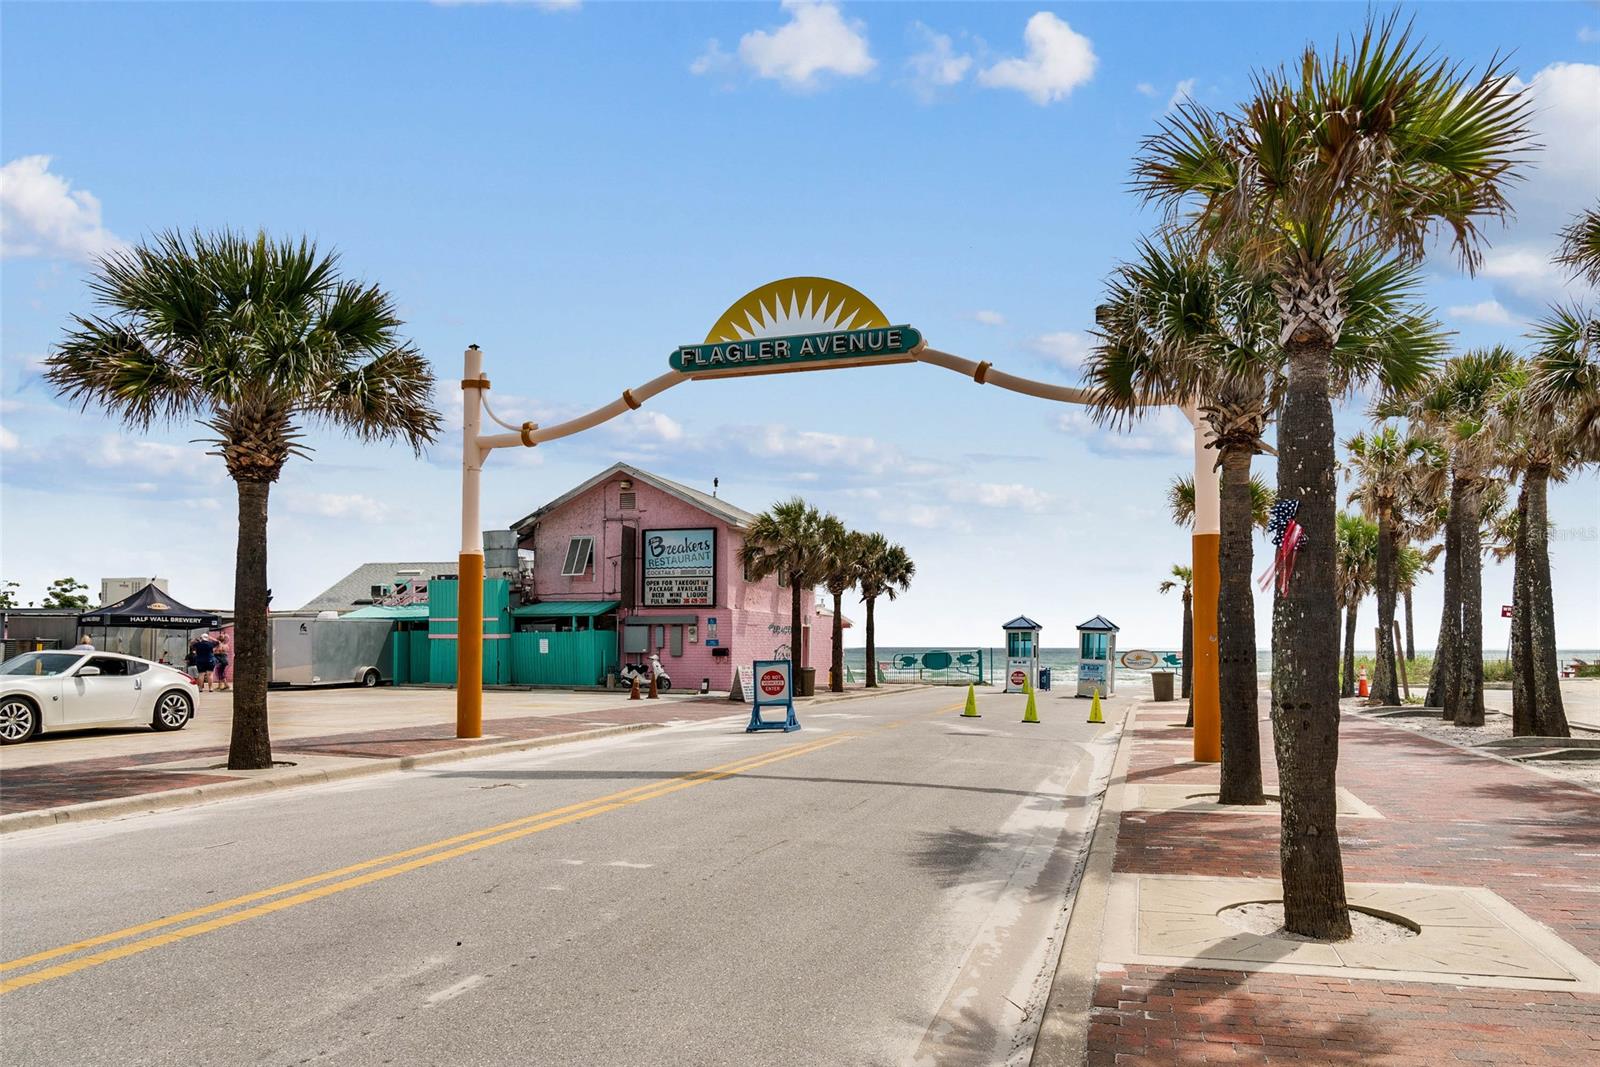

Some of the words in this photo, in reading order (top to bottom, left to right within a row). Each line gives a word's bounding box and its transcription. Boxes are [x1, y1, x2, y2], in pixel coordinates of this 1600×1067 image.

[680, 340, 790, 366] FLAGLER
[799, 329, 902, 355] AVENUE
[649, 536, 710, 557] Breakers
[648, 551, 711, 567] RESTAURANT
